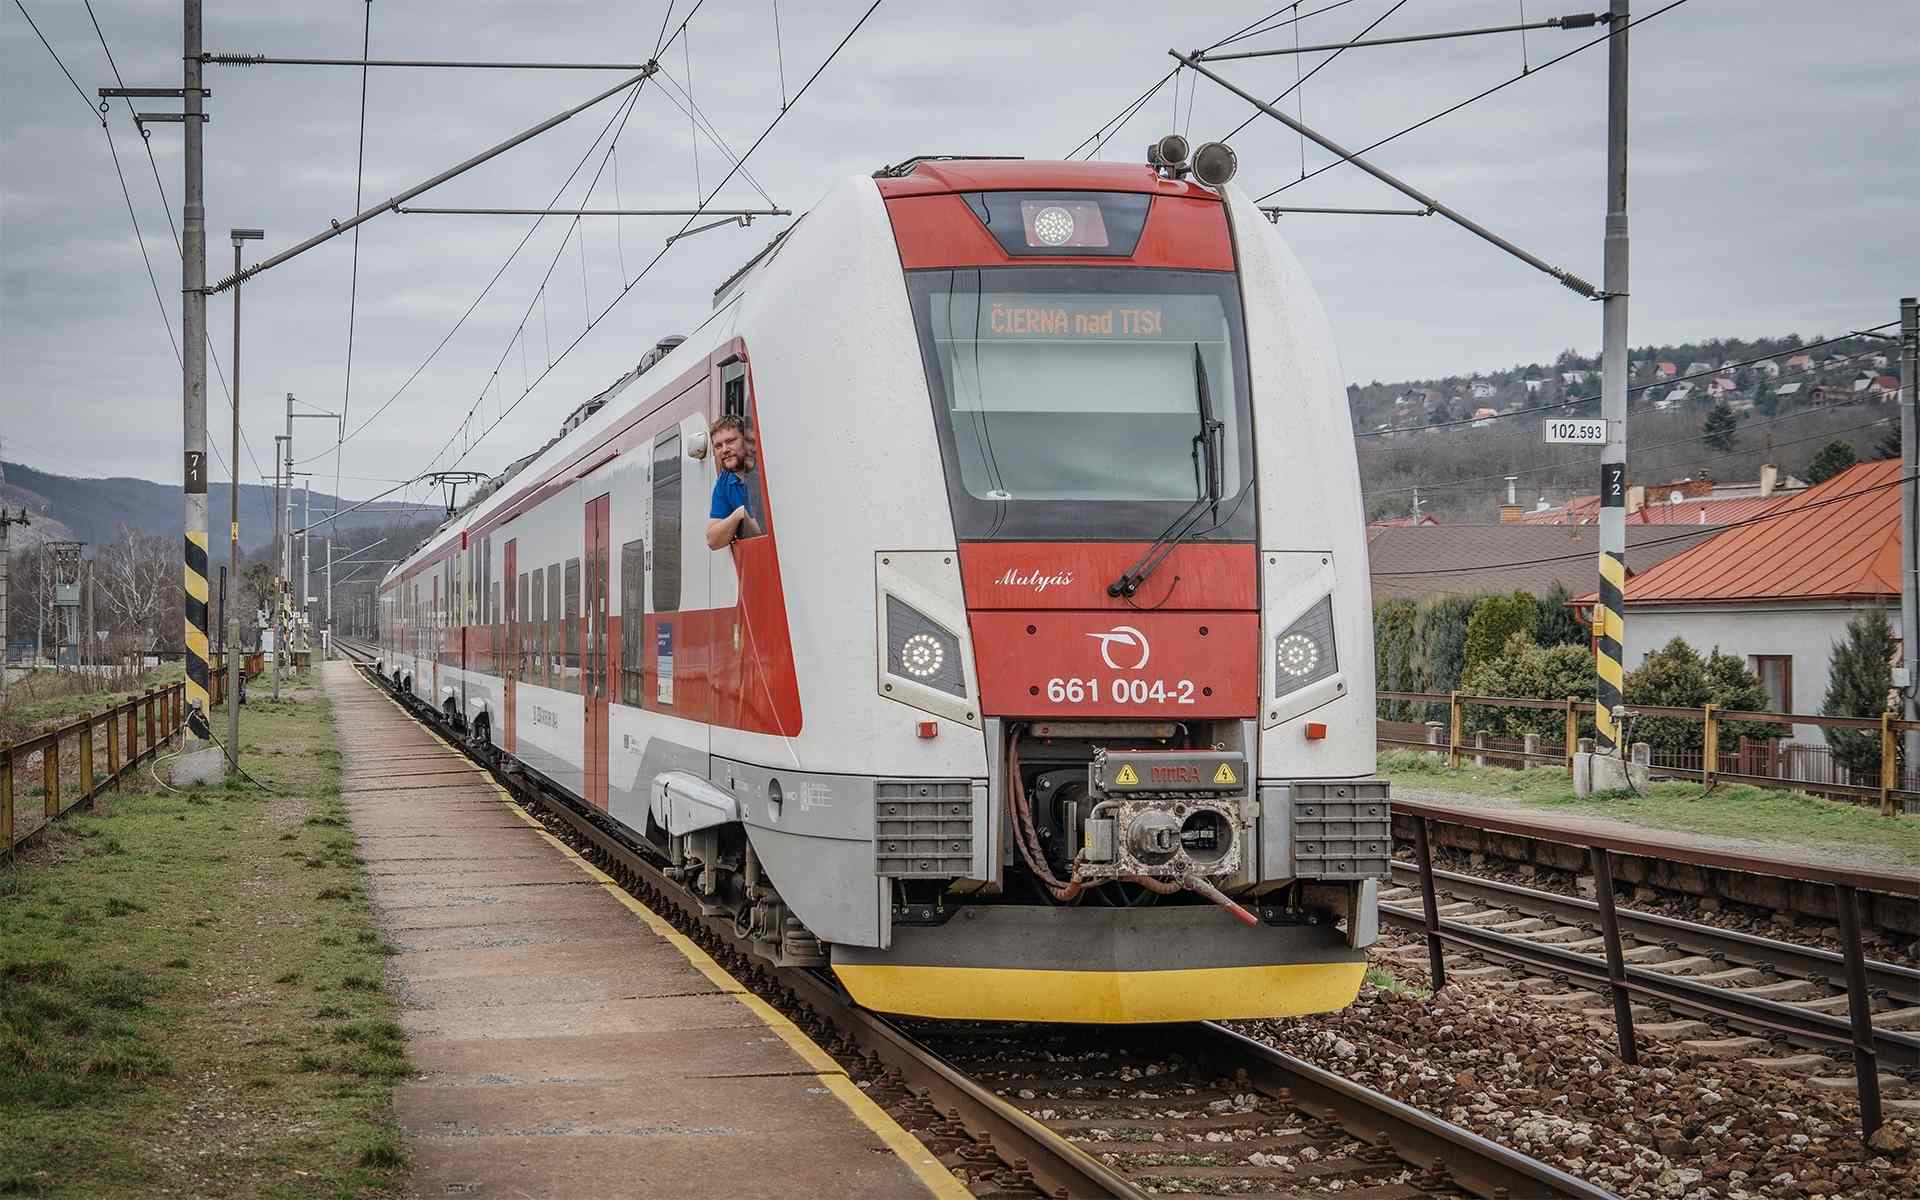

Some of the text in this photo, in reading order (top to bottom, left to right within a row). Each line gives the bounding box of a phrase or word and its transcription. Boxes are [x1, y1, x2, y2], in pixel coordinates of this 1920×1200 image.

[1076, 310, 1112, 333] nad
[1551, 423, 1602, 439] 102.593
[1047, 678, 1195, 704] 661 004-2
